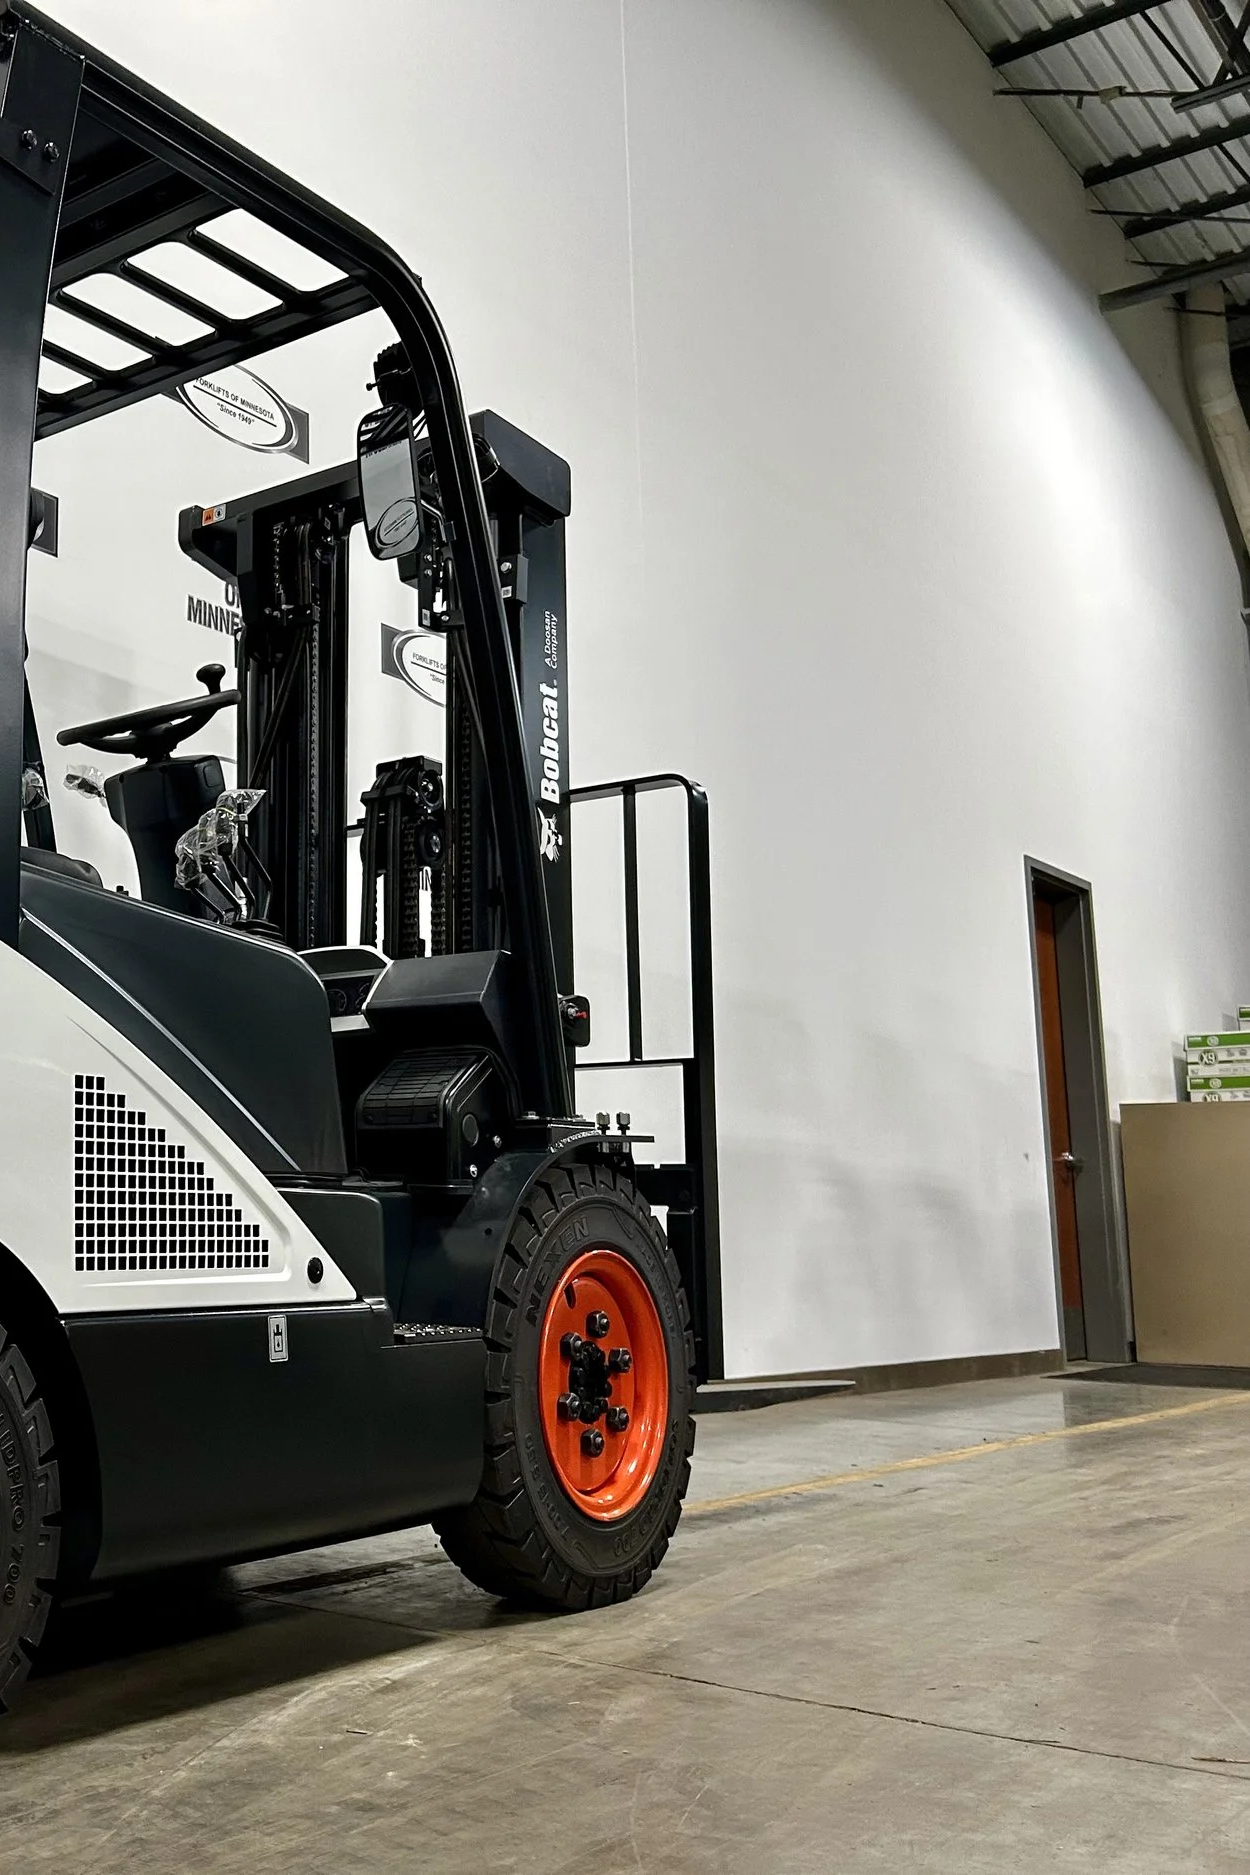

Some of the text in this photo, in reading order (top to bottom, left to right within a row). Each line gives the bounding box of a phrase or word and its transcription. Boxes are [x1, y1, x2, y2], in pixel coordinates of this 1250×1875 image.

[231, 393, 239, 403] OF
[240, 398, 274, 421] MINNESOTA
[544, 657, 551, 667] A
[550, 613, 559, 670] Company
[540, 682, 561, 804] Bobcat
[1201, 1052, 1216, 1065] X9
[525, 1216, 590, 1327] NEXEN
